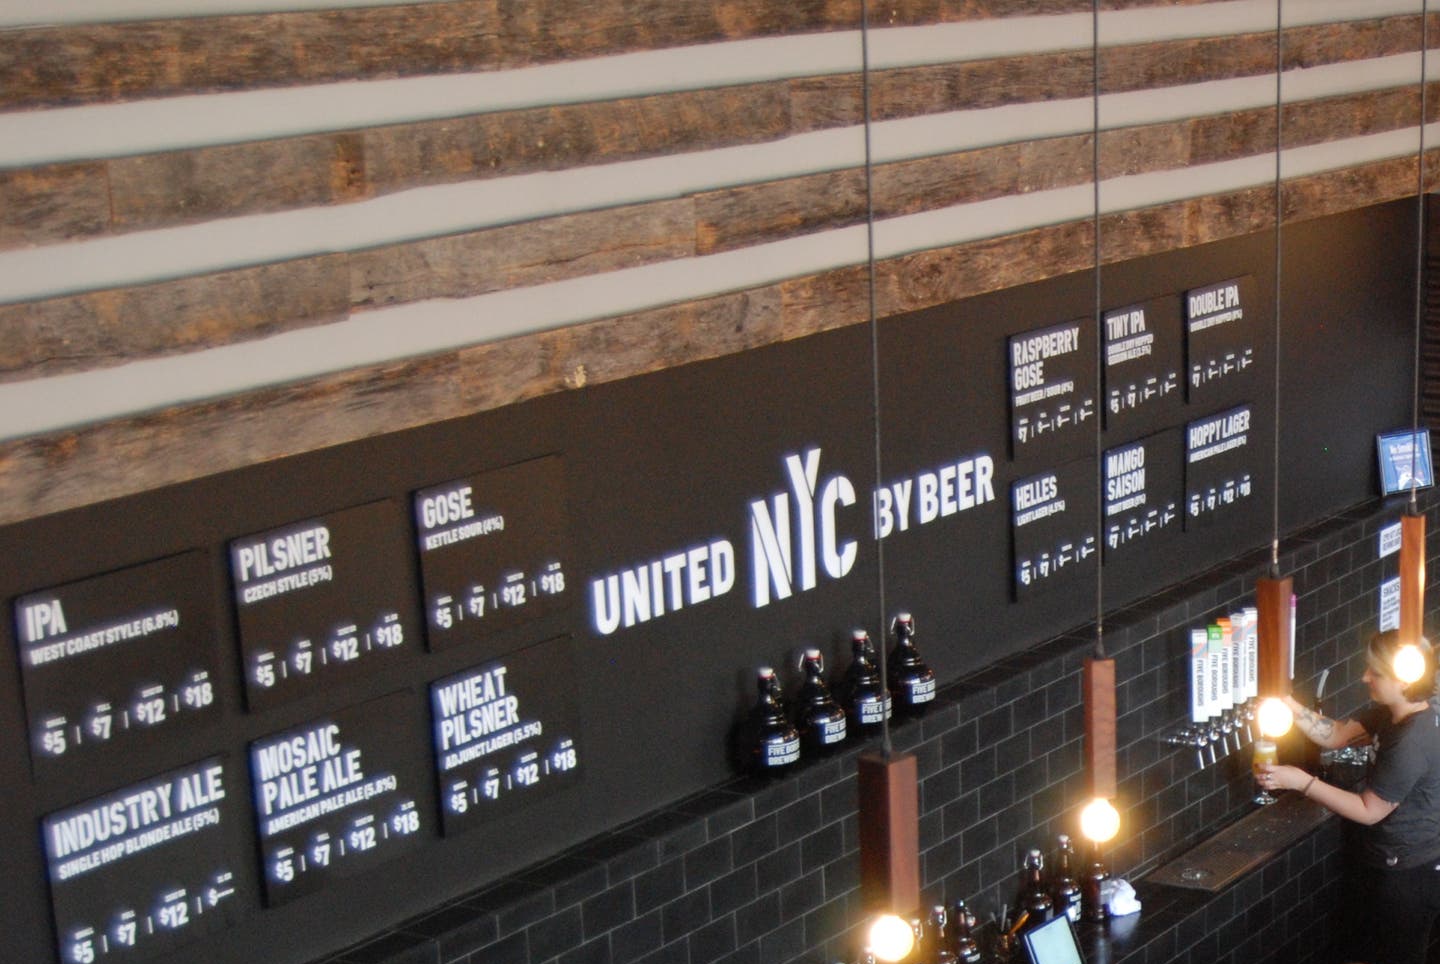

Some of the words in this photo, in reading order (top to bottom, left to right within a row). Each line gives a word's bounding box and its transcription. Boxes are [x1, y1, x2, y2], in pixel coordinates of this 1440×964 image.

[1107, 313, 1129, 341] TINY
[1130, 309, 1146, 334] IPA
[1190, 288, 1224, 318] DOUBLE
[1226, 285, 1239, 308] IPA
[1013, 327, 1079, 367] RASPBERRY
[1015, 361, 1044, 391] GOSE
[1190, 419, 1222, 450] HOPPY
[1223, 410, 1250, 438] LAGER
[1108, 446, 1145, 479] MANGO
[1108, 467, 1146, 500] SAISON
[423, 487, 475, 528] GOSE
[1016, 475, 1057, 511] HELLES
[239, 526, 332, 582] PILSNER
[425, 531, 459, 550] KETTLE
[459, 521, 483, 540] SOUR
[592, 540, 735, 635] UNITED
[750, 447, 859, 609] NYC
[873, 479, 913, 541] BY
[919, 455, 996, 525] BEER
[244, 580, 277, 604] CZECH
[277, 571, 308, 594] STYLE
[308, 564, 333, 586] (5%)
[436, 607, 452, 628] $5
[470, 596, 485, 617] $7
[503, 584, 526, 606] $12
[541, 572, 565, 594] $18
[25, 599, 67, 642] IPA
[30, 642, 66, 665] WEST
[66, 632, 106, 656] COAST
[106, 620, 142, 644] STYLE
[142, 609, 180, 636] (6.8%)
[256, 664, 275, 687] $5
[295, 651, 312, 674] $7
[332, 637, 359, 661] $12
[376, 623, 403, 647] $18
[43, 730, 66, 754] $5
[92, 715, 112, 739] $7
[136, 699, 166, 724] $12
[185, 682, 214, 708] $18
[438, 666, 507, 718] WHEAT
[441, 695, 519, 750] PILSNER
[258, 724, 341, 781] MOSAIC
[445, 741, 487, 770] ADJUNCT
[487, 732, 514, 753] LAGER
[263, 765, 319, 815] PALE
[323, 750, 363, 793] ALE
[268, 804, 321, 835] AMERICAN
[321, 795, 345, 815] PALE
[345, 787, 365, 806] ALE
[364, 775, 397, 800] (5.8%)
[451, 792, 468, 813] $5
[485, 778, 499, 799] $7
[517, 763, 540, 786] $12
[554, 748, 577, 771] $18
[53, 783, 173, 858] INDUSTRY
[179, 765, 225, 812] ALE
[59, 853, 100, 880] SINGLE
[100, 844, 124, 864] HOP
[126, 825, 172, 855] BLONDE
[171, 818, 193, 837] ALE
[193, 808, 220, 832] (5%)
[276, 859, 295, 882] $5
[314, 844, 330, 866] $7
[351, 827, 377, 850] $12
[393, 810, 420, 834] $18
[73, 940, 94, 964] $5
[118, 922, 137, 946] $7
[160, 901, 190, 928] $12
